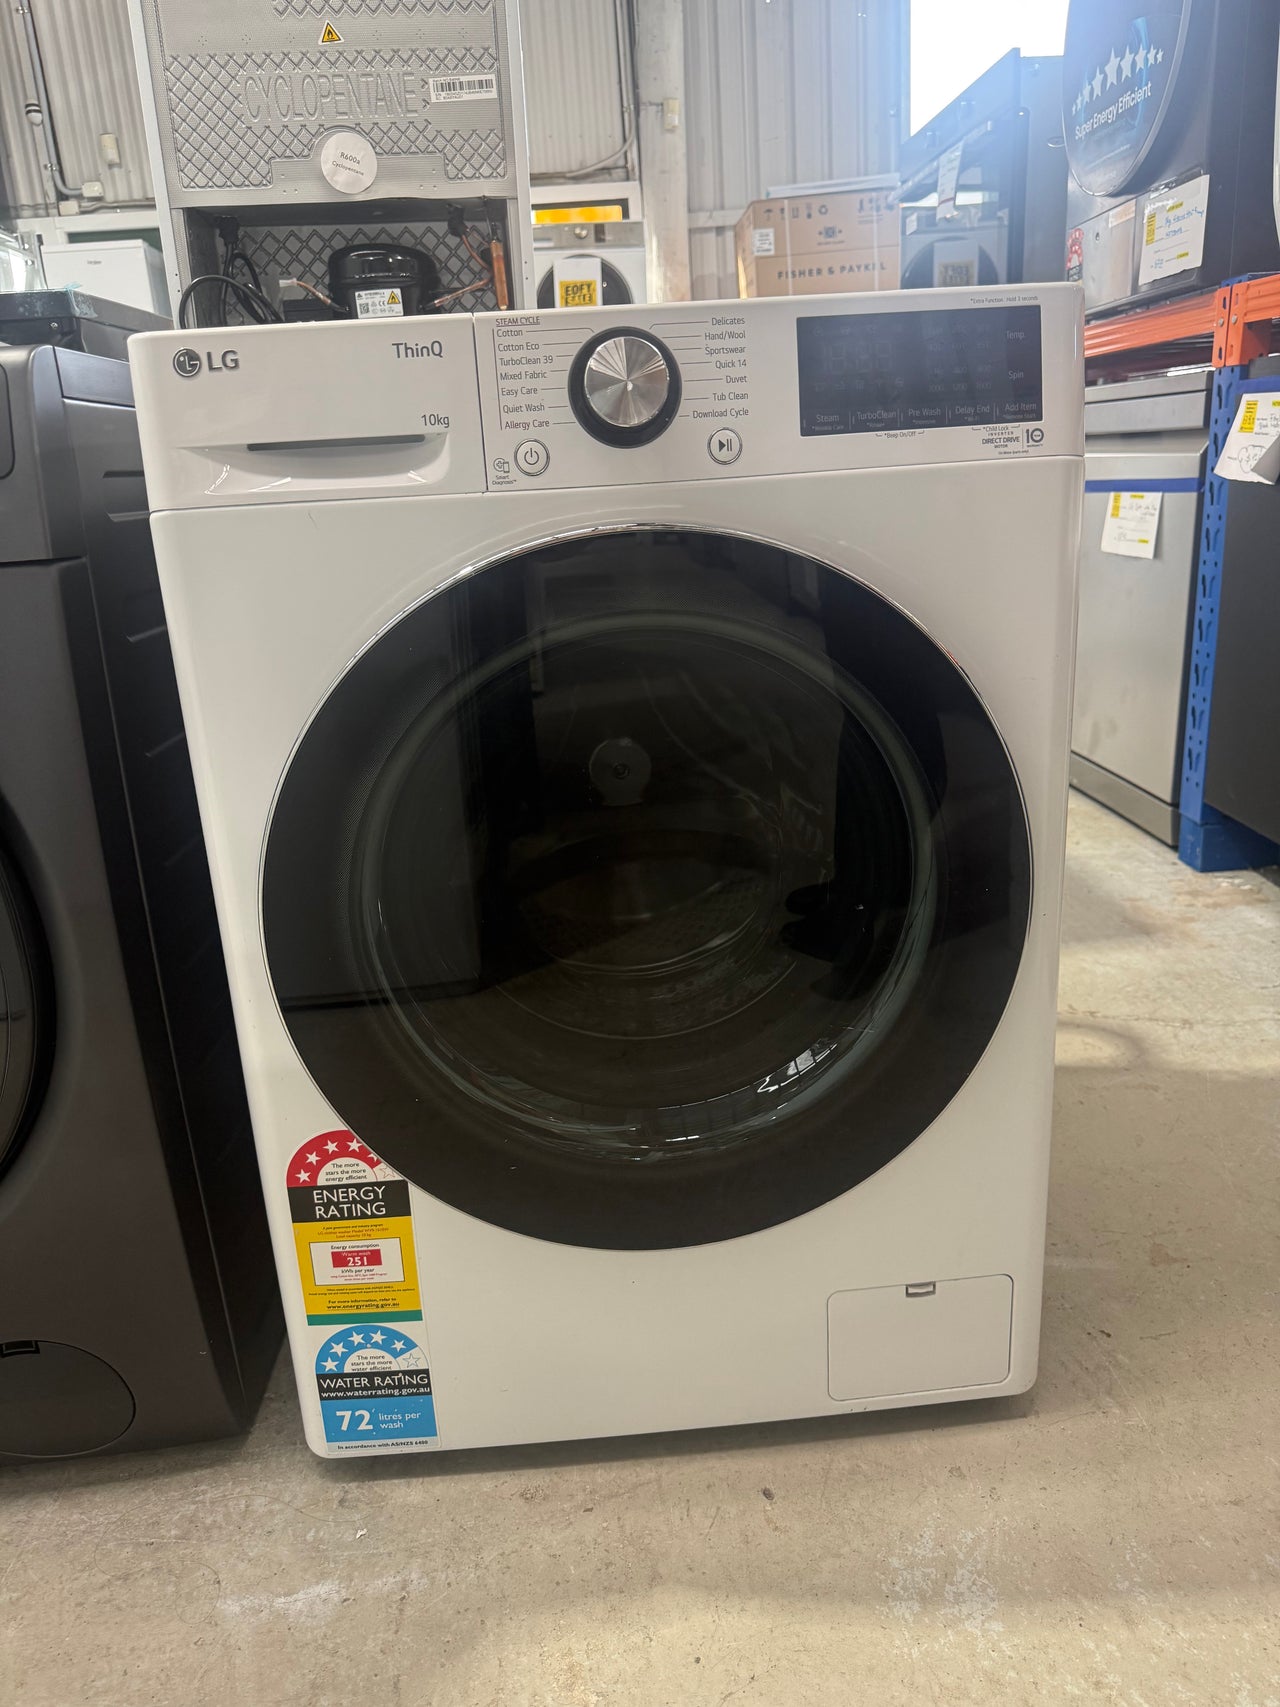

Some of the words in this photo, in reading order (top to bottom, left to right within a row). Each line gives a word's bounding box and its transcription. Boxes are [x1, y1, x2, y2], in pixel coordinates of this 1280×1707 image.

[244, 73, 419, 122] CYCLOPENTANE
[1076, 119, 1094, 140] Super
[1094, 103, 1118, 129] Energy
[1118, 80, 1152, 114] Efficient
[340, 152, 360, 165] R600a
[332, 160, 364, 176] Cyclopentane
[777, 268, 822, 280] FISHER
[828, 266, 835, 276] &
[564, 284, 592, 296] EOFY
[495, 317, 518, 326] STEAM
[520, 316, 540, 324] CYCLE
[712, 317, 746, 325] Delicates
[496, 328, 523, 337] Cotton
[704, 330, 746, 340] Hand/Wool
[392, 340, 444, 360] ThinQ
[498, 343, 524, 352] Cotton
[526, 342, 540, 350] Eco
[705, 347, 746, 357] Sportswear
[206, 350, 240, 372] LG
[500, 357, 541, 366] TurboClean
[543, 355, 553, 364] 39
[715, 360, 736, 370] Quick
[738, 359, 747, 367] 14
[500, 372, 522, 380] Mixed
[524, 370, 547, 379] Fabric
[1008, 370, 1024, 380] Spin
[501, 387, 518, 397] Easy
[520, 386, 538, 394] Care
[712, 392, 726, 401] Tub
[728, 392, 748, 400] Clean
[503, 405, 523, 414] Quiet
[525, 403, 545, 412] Wash
[909, 409, 920, 417] Pre
[922, 407, 941, 416] Wash
[955, 405, 974, 415] Delay
[976, 404, 990, 413] End
[1005, 402, 1019, 411] Add
[1020, 402, 1037, 411] Item
[692, 409, 728, 418] Download
[730, 407, 749, 418] Cycle
[857, 410, 896, 420] TurboClean
[421, 414, 450, 428] 10kg
[816, 414, 839, 423] Steam
[505, 422, 530, 430] Allergy
[1026, 428, 1044, 444] 10
[313, 1186, 385, 1204] ENERGY
[315, 1202, 386, 1219] RATING
[347, 1256, 368, 1266] 251
[320, 1377, 370, 1389] WATER
[374, 1374, 428, 1386] RATING
[321, 1387, 430, 1398] www.waterrating.gov.au
[336, 1409, 373, 1431] 72
[405, 1412, 421, 1421] per
[380, 1420, 404, 1429] wash
